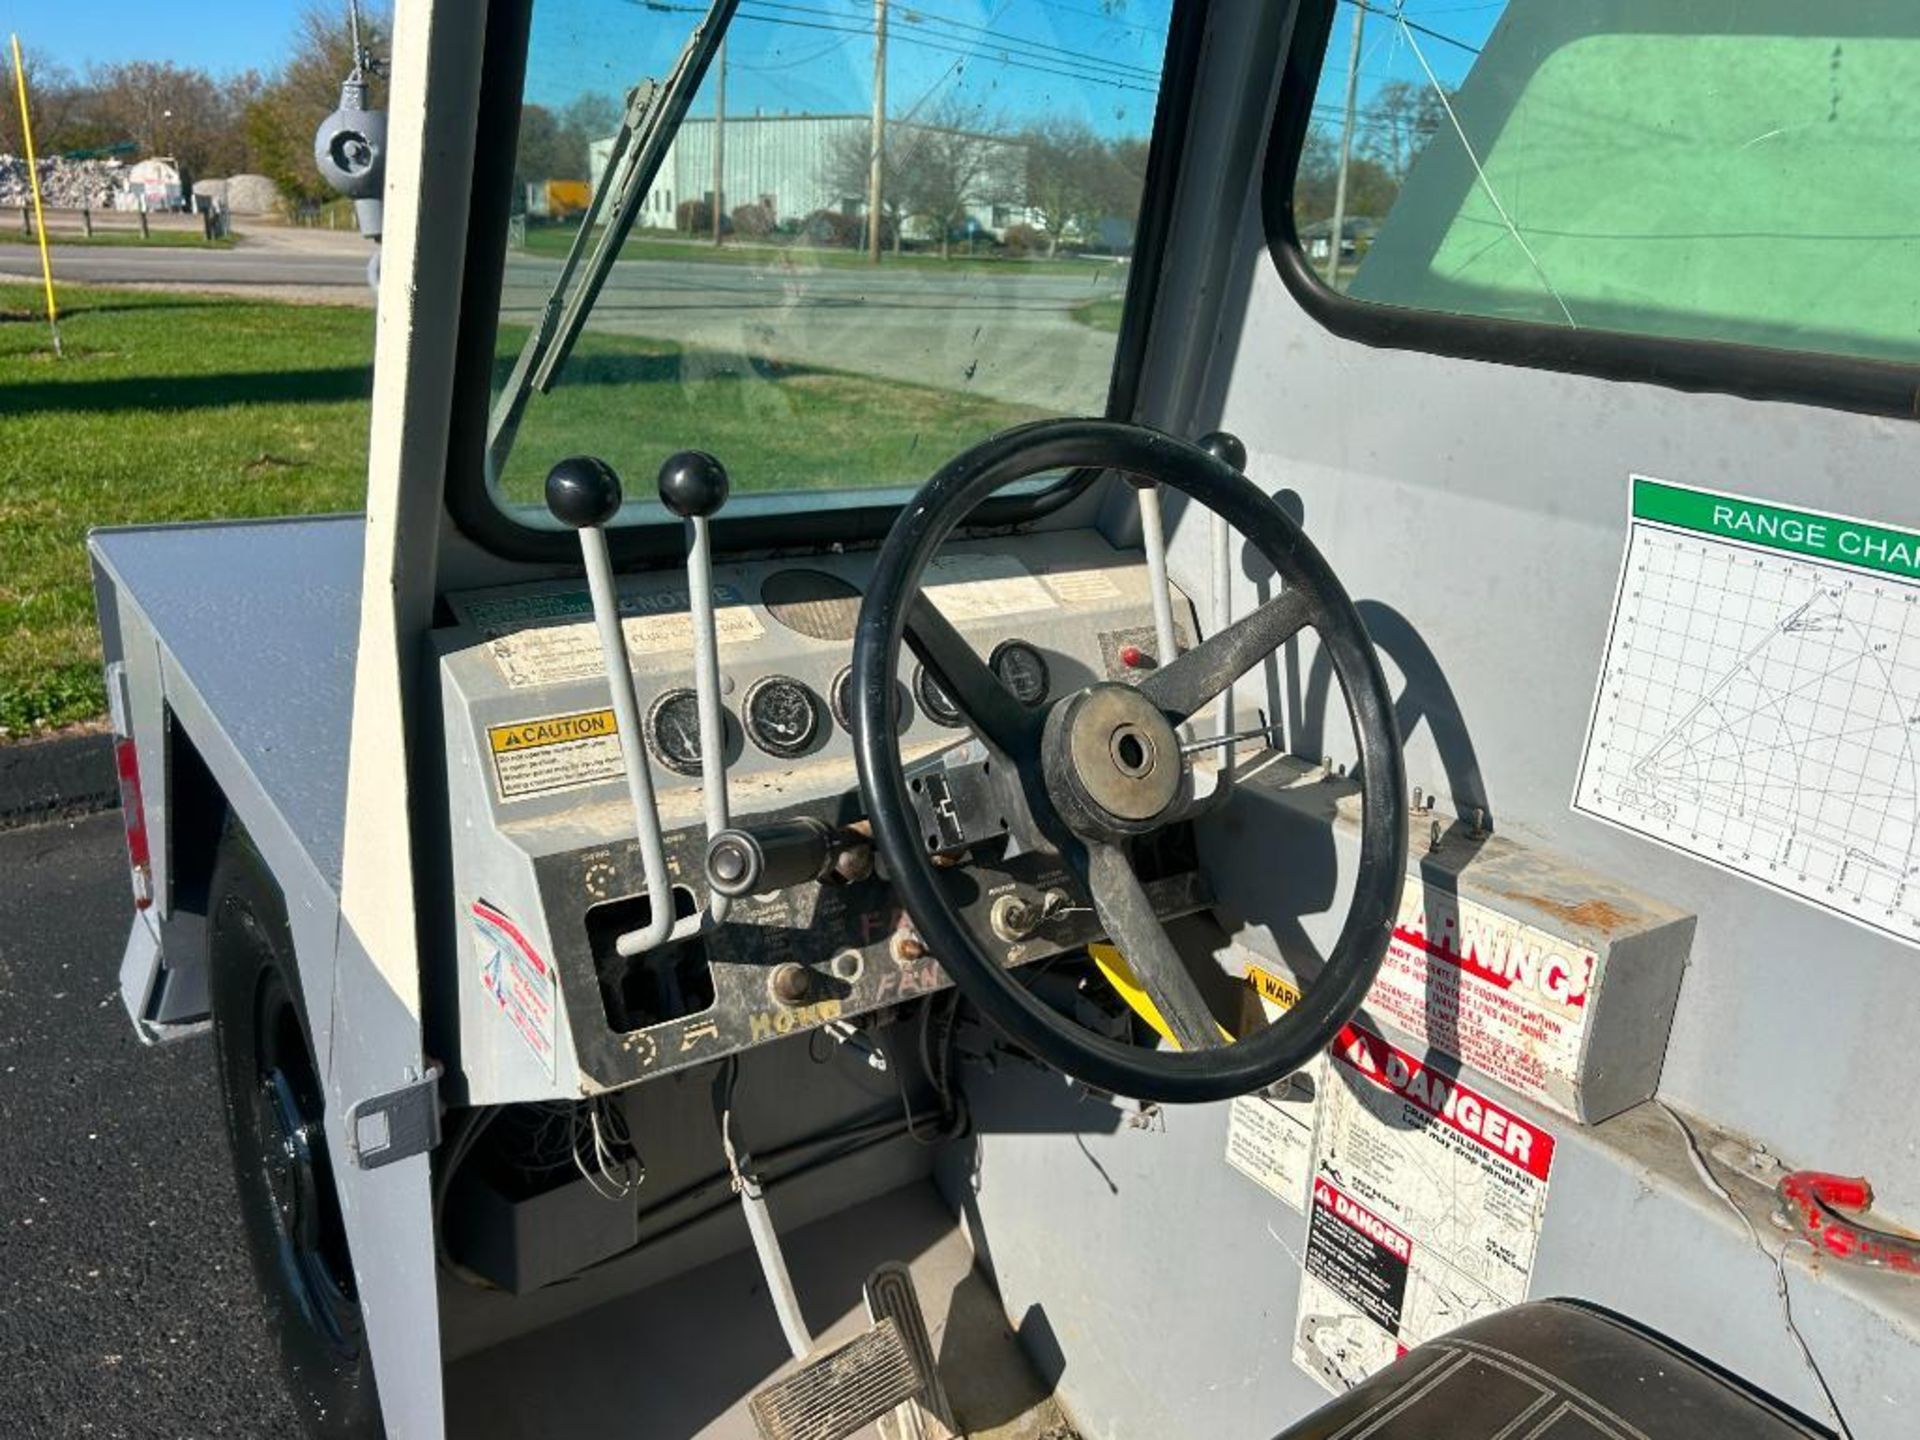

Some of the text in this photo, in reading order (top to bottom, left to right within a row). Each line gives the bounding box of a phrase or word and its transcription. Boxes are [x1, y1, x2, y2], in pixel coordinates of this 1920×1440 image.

[1713, 504, 1920, 569] RANGE CHA
[522, 716, 605, 743] CAUTION
[1388, 946, 1412, 962] NOT
[1395, 904, 1572, 1005] ARNING
[1385, 1052, 1533, 1164] DANGER
[1404, 1103, 1439, 1133] CRANE
[1441, 1127, 1490, 1161] FAILURE
[1491, 1156, 1513, 1176] can
[1428, 1131, 1451, 1150] may
[1453, 1146, 1479, 1166] drop
[1335, 1195, 1409, 1265] DANGER
